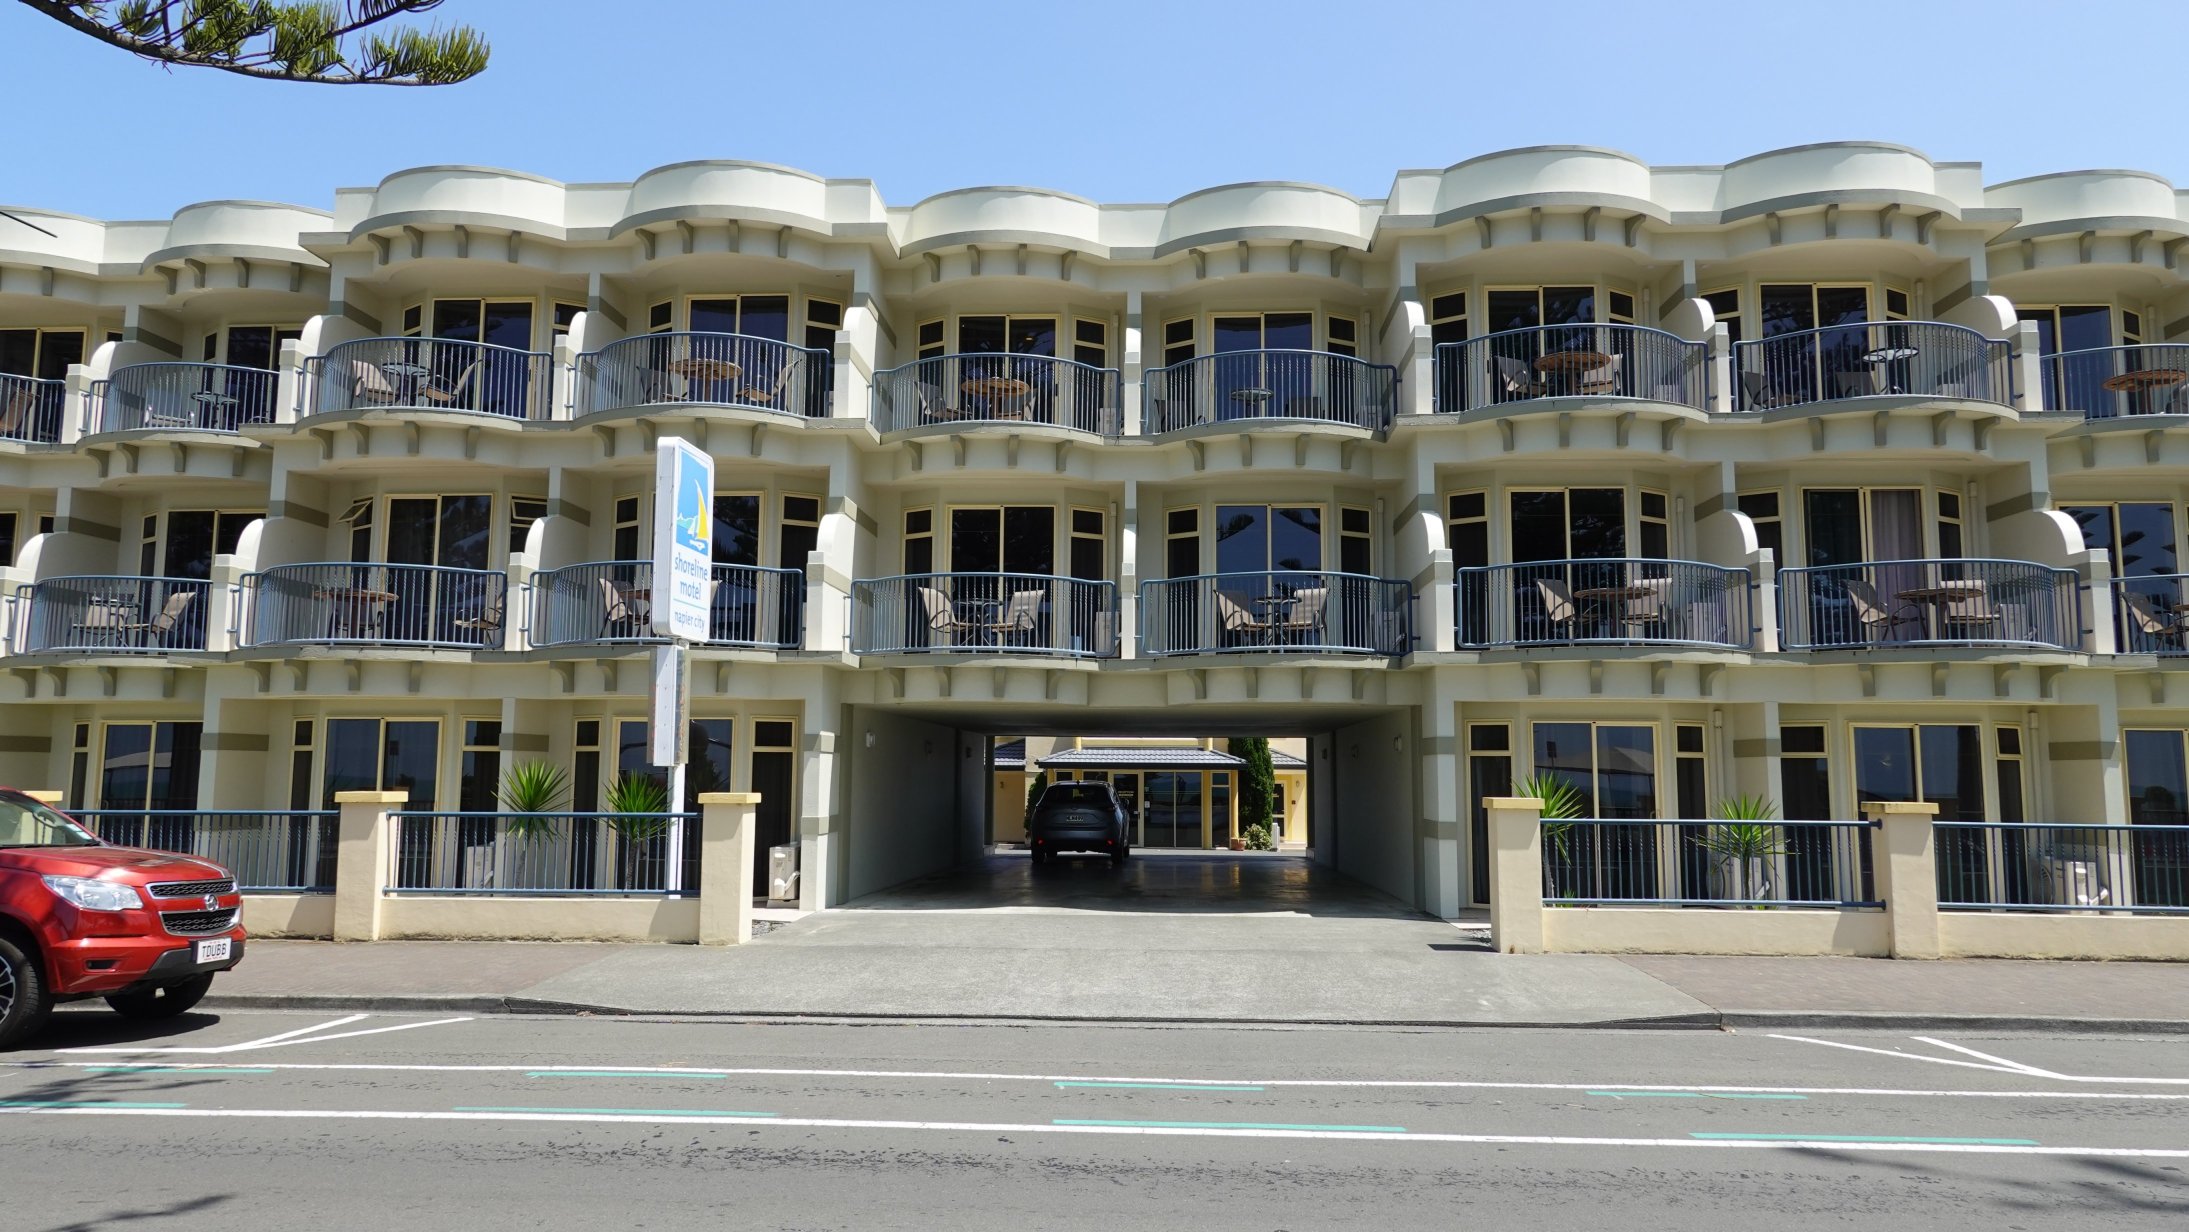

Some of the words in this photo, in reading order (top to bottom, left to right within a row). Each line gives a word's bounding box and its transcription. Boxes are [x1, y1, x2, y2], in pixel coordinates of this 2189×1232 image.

[674, 552, 708, 581] shoreline
[680, 580, 702, 600] motel
[674, 610, 693, 628] napier
[693, 614, 705, 633] city
